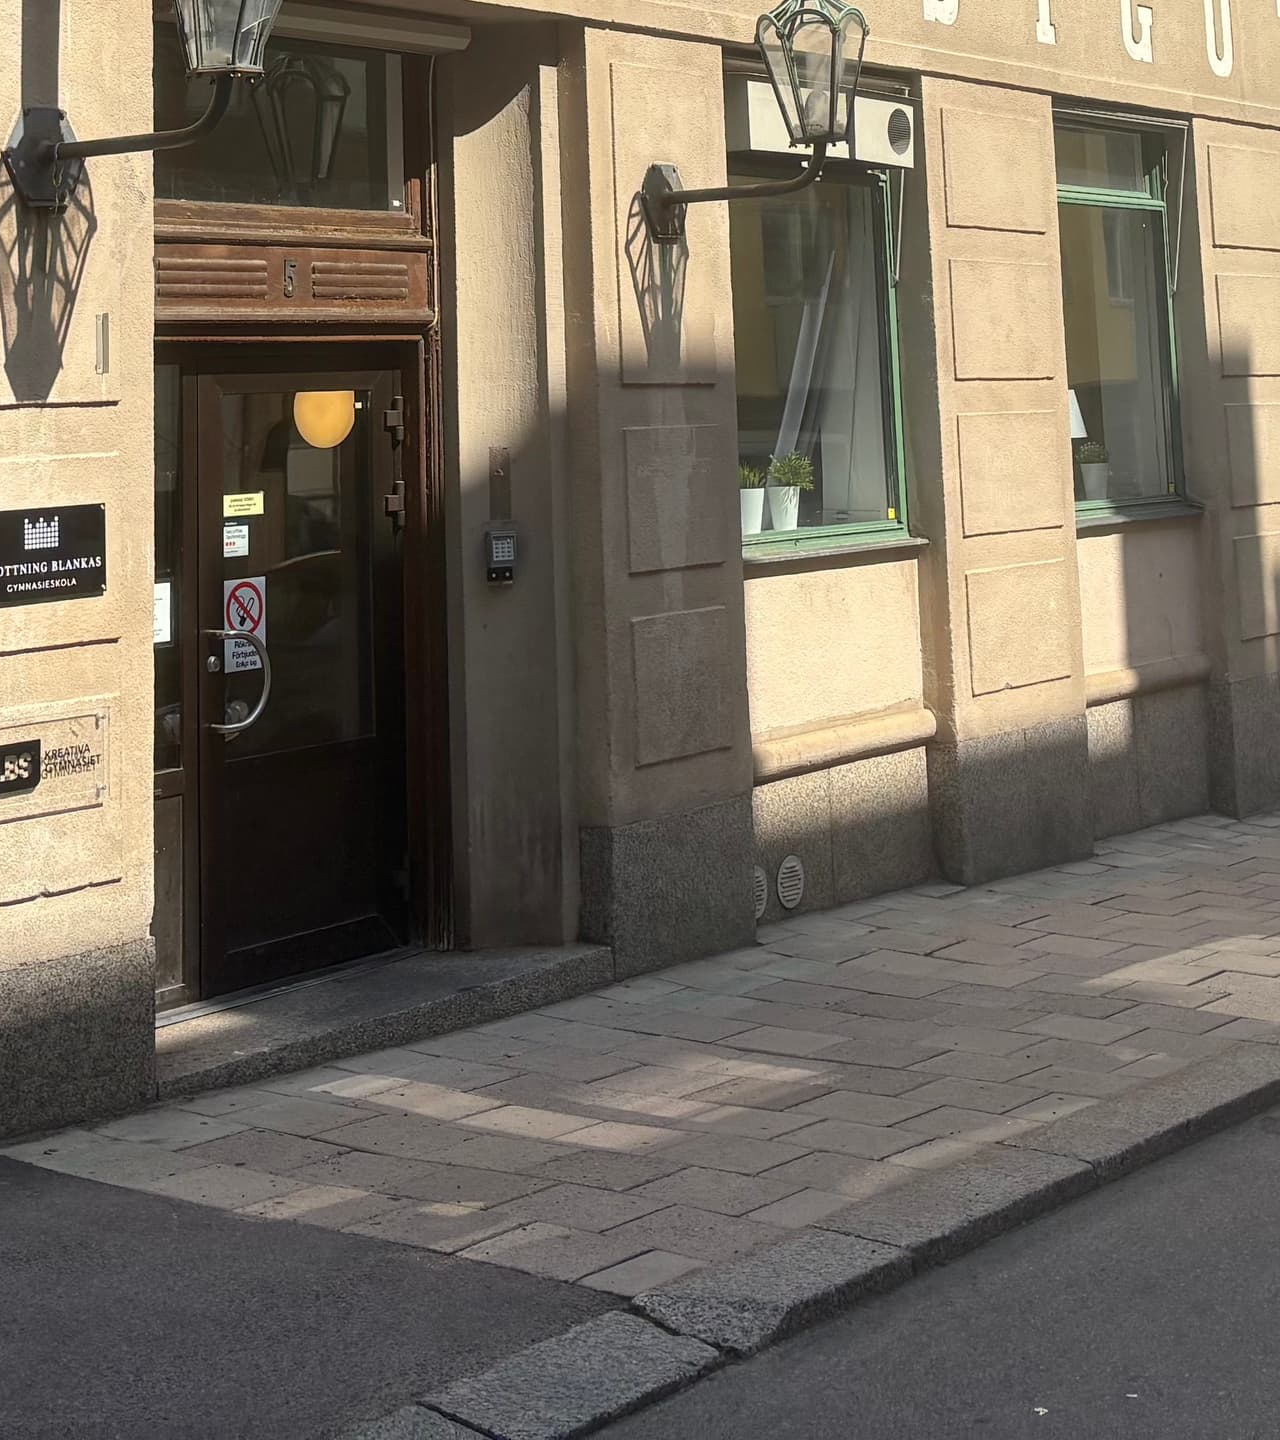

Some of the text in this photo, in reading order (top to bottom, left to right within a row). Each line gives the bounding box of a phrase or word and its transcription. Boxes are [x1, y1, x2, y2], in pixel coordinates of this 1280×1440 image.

[51, 556, 102, 572] BLANKAS
[6, 577, 78, 593] GYMNASIESKOLA
[44, 743, 91, 761] KREATIVA
[45, 754, 101, 773] GYMNASIET
